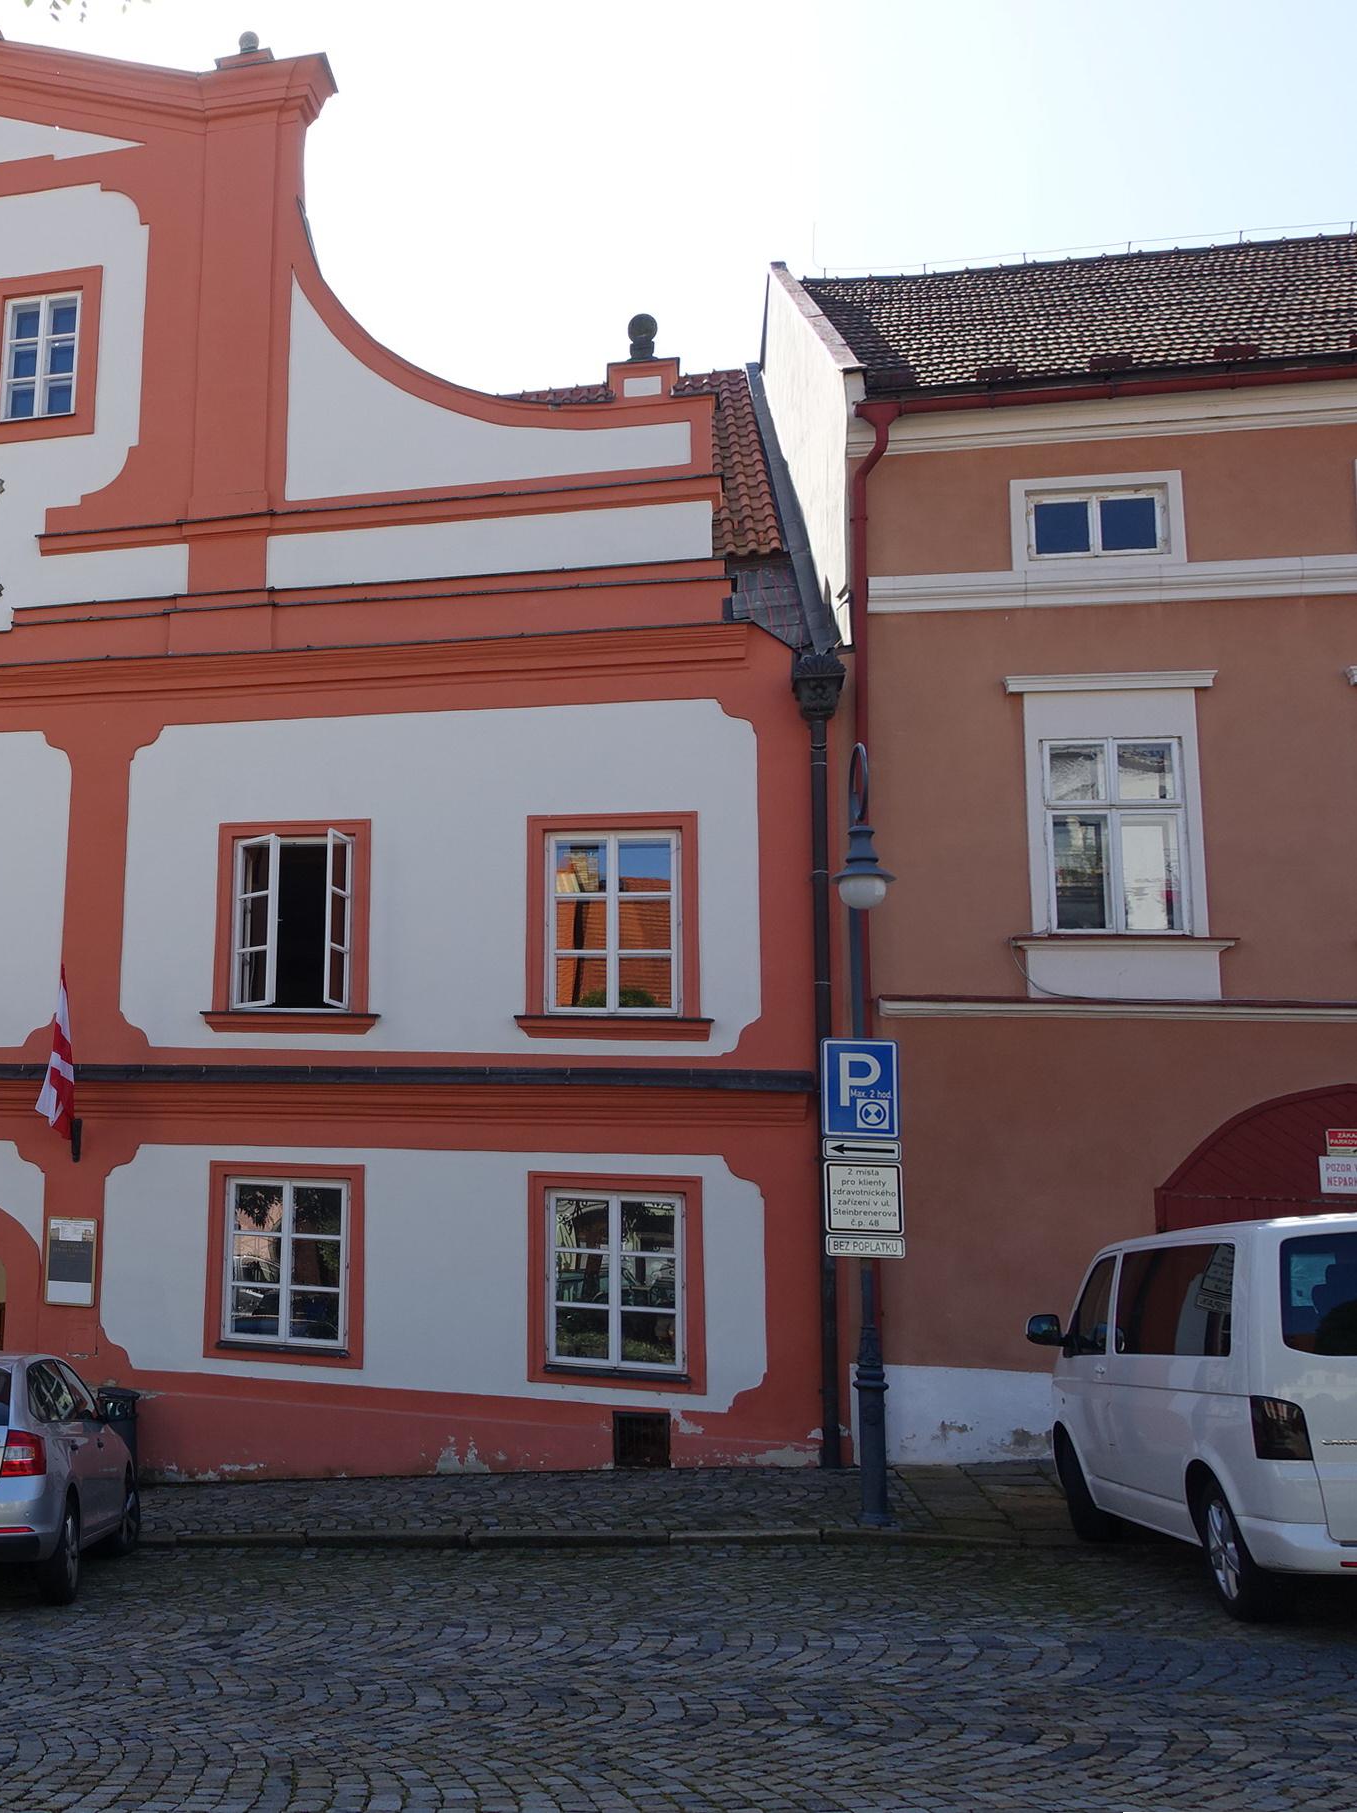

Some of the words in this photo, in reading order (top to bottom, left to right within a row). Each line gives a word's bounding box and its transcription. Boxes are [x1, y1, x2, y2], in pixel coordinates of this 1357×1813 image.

[839, 1052, 881, 1107] P
[870, 1088, 876, 1099] 2
[877, 1088, 893, 1099] hod.
[847, 1168, 853, 1176] 2
[1325, 1163, 1352, 1173] POZOR
[841, 1179, 856, 1187] pro
[858, 1178, 887, 1188] klienty
[832, 1188, 897, 1198] zdravotnického
[833, 1208, 897, 1218] Steinbrenerova
[868, 1219, 880, 1227] 48
[833, 1240, 850, 1251] BEZ
[852, 1240, 898, 1253] POPLATKU
